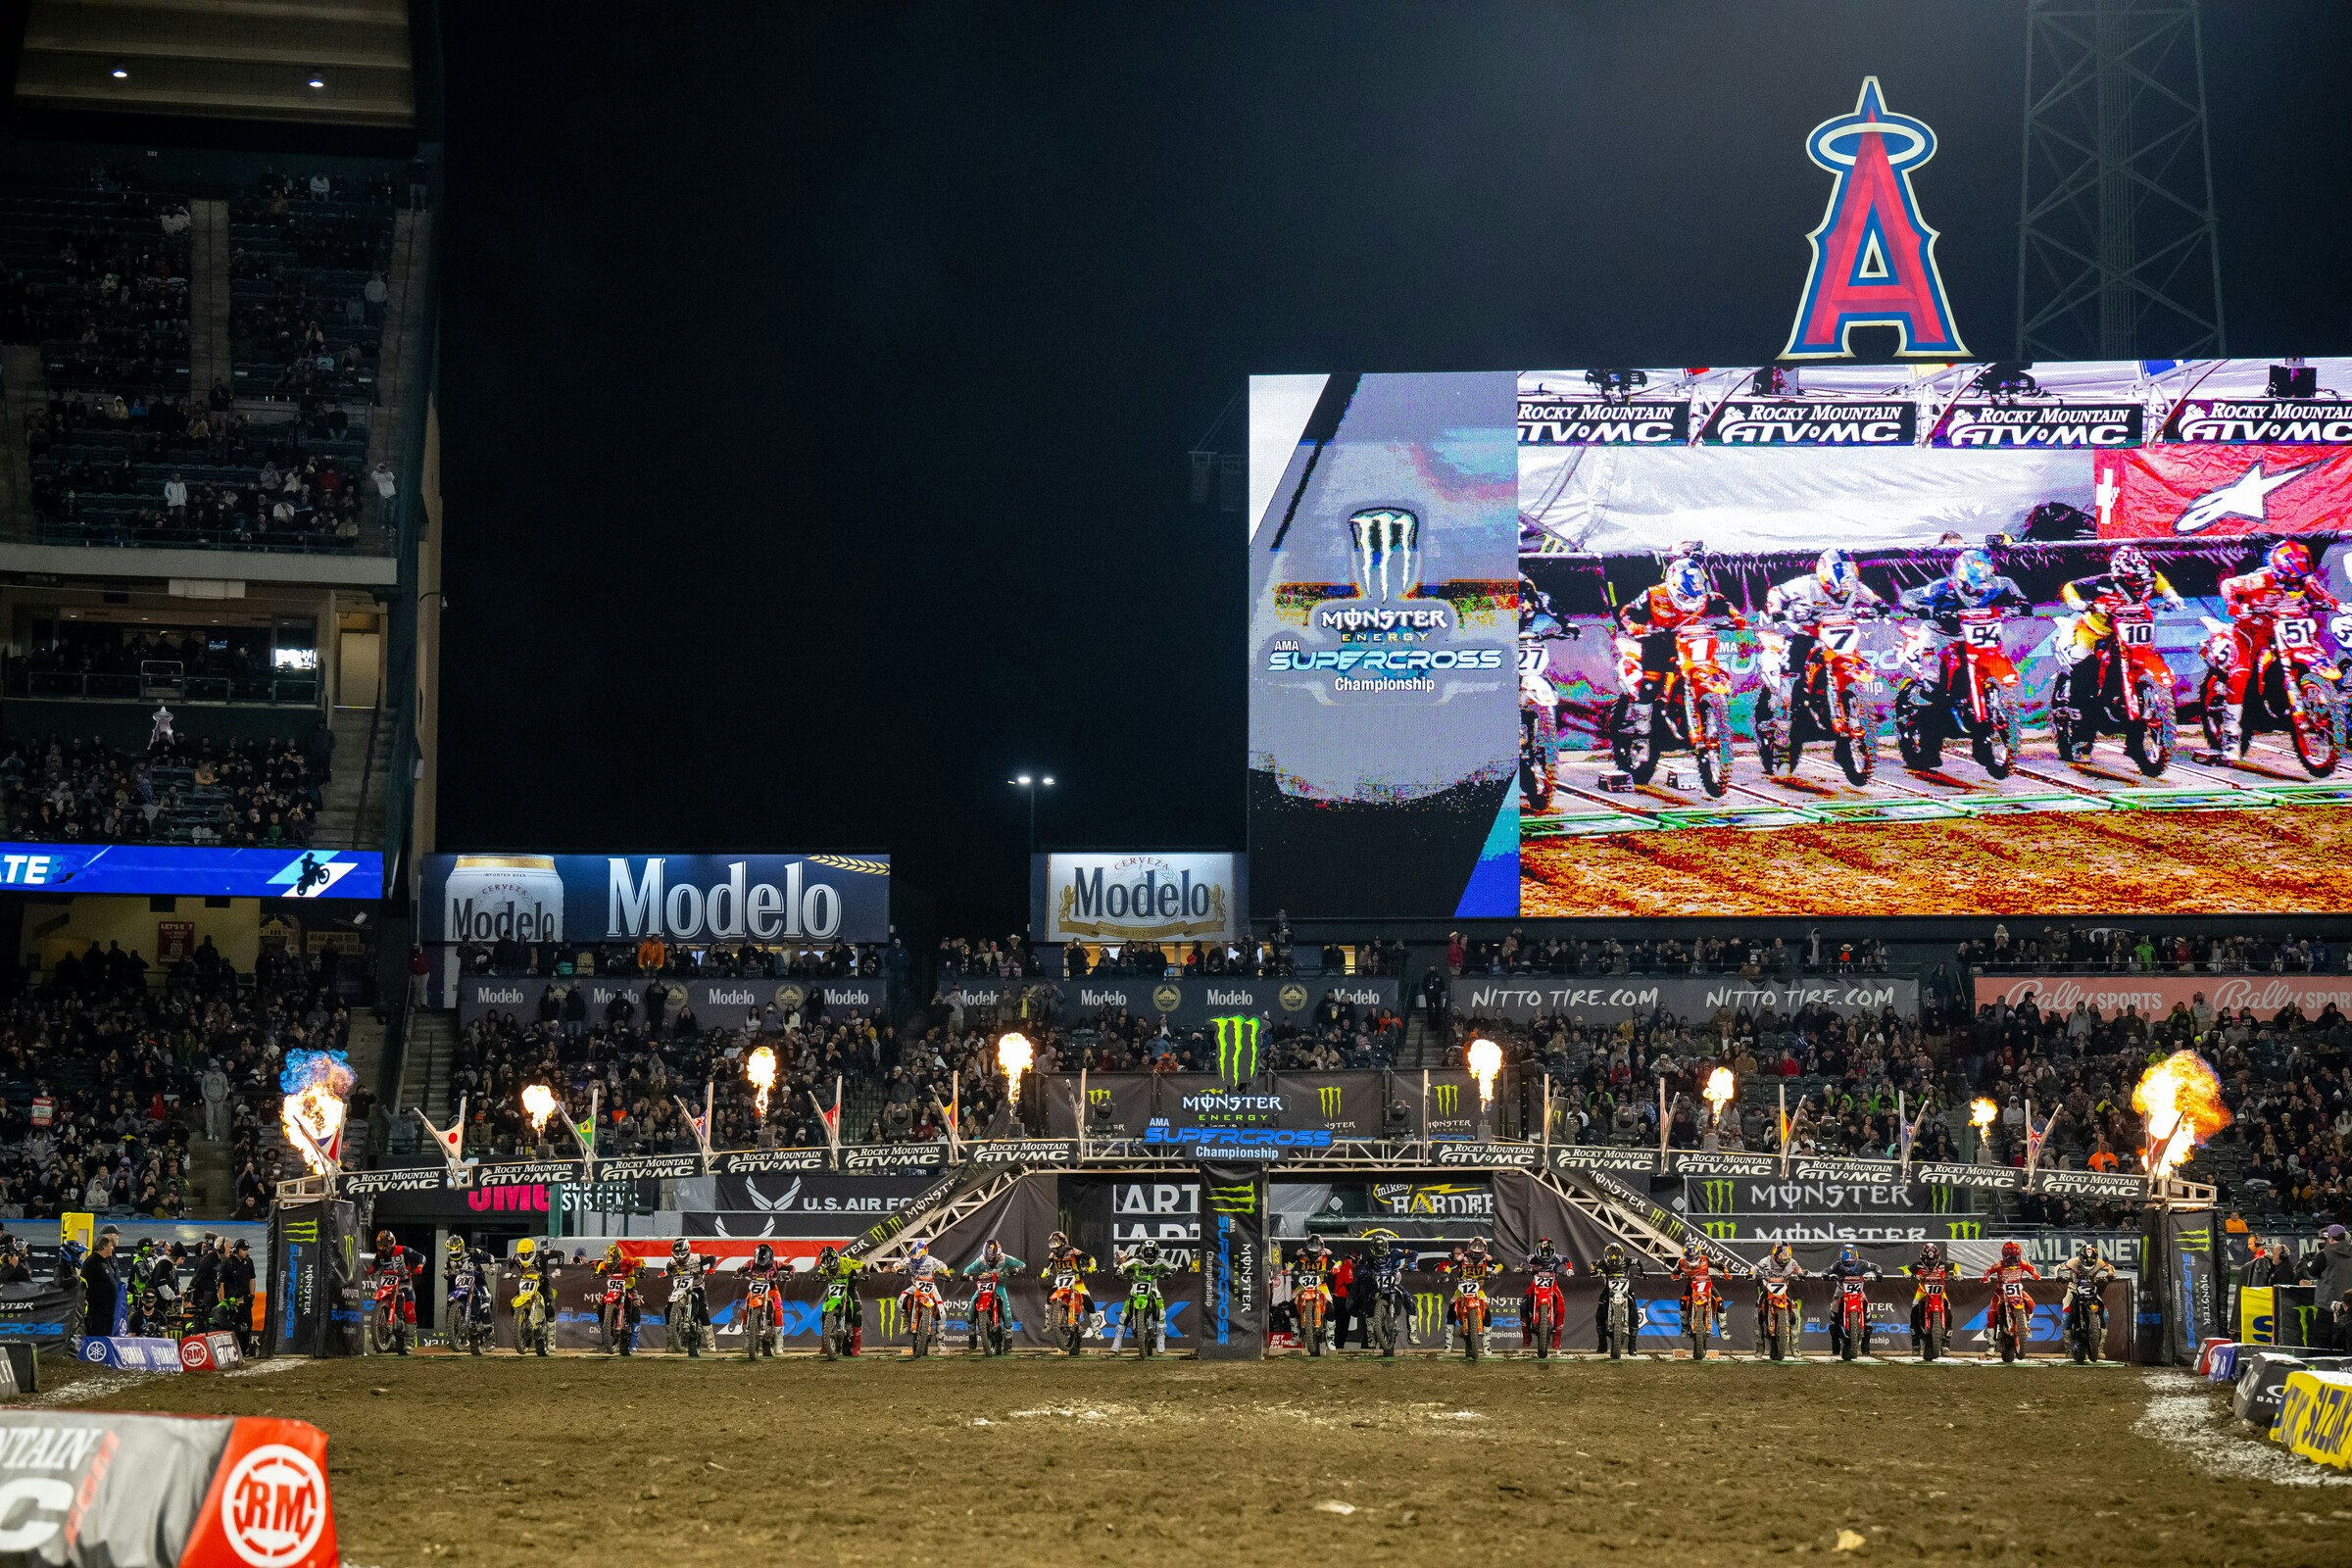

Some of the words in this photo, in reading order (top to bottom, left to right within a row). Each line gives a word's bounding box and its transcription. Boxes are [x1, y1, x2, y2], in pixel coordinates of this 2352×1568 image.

[1518, 404, 1574, 419] ROCKY
[1578, 405, 1675, 420] MOUNTAIN
[1748, 404, 1808, 420] ROCKY
[1810, 405, 1903, 420] MOUNTAIN
[1977, 407, 2038, 423] ROCKY
[2040, 408, 2129, 423] MOUNTAIN
[2209, 403, 2270, 418] ROCKY
[2270, 403, 2352, 419] MOUNTAI
[1321, 608, 1448, 631] MONSTER
[1341, 633, 1430, 642] ENERGY
[2125, 624, 2151, 645] 10
[2284, 620, 2313, 644] 51
[1274, 640, 1299, 651] AMA
[1829, 629, 1854, 651] 7
[1689, 638, 1709, 662] 1
[1267, 650, 1504, 671] SUPERCROSS
[1334, 676, 1435, 693] Championship
[0, 855, 51, 884] TE
[1113, 856, 1171, 871] CERVEZA
[481, 883, 527, 896] CERVEZA
[1073, 866, 1210, 918] Modelo
[606, 858, 843, 940] Modelo
[451, 897, 556, 942] Modelo
[477, 987, 524, 1004] Modelo
[709, 988, 755, 1004] Modelo
[823, 988, 869, 1004] Modelo
[1080, 989, 1127, 1005] Modelo
[1206, 989, 1253, 1005] Modelo
[1471, 986, 1543, 1008] NITTO
[1548, 986, 1659, 1008] TIRE.COM
[1705, 985, 1777, 1008] NITTO
[1784, 986, 1894, 1008] TIRE.COM
[2096, 992, 2163, 1010] SPORTS
[2305, 992, 2352, 1008] SPOR
[1182, 1093, 1284, 1115] MONSTER
[1150, 1117, 1170, 1127] AMA
[1143, 1127, 1333, 1147] SUPERCROSS
[859, 1148, 890, 1156] ROCKY
[891, 1146, 940, 1155] MOUNTAIN
[989, 1143, 1018, 1152] ROCKY
[1019, 1142, 1069, 1152] MOUNTAIN
[1196, 1146, 1280, 1160] Championship
[1453, 1144, 1484, 1153] ROCKY
[1485, 1145, 1536, 1154] MOUNTAIN
[741, 1152, 771, 1161] ROCKY
[772, 1151, 822, 1159] MOUNTAIN
[1572, 1149, 1602, 1157] ROCKY
[1603, 1150, 1654, 1160] MOUNTAIN
[1691, 1153, 1721, 1162] ROCKY
[1722, 1154, 1773, 1165] MOUNTAIN
[494, 1165, 523, 1174] ROCKY
[524, 1163, 572, 1173] MOUNTAIN
[614, 1160, 644, 1169] ROCKY
[645, 1157, 695, 1167] MOUNTAIN
[1812, 1160, 1842, 1169] ROCKY
[1843, 1162, 1893, 1172] MOUNTAIN
[1934, 1163, 1964, 1174] ROCKY
[1965, 1166, 2015, 1177] MOUNTAIN
[361, 1173, 391, 1183] ROCKY
[392, 1170, 439, 1181] MOUNTAIN
[2058, 1173, 2088, 1182] ROCKY
[2089, 1175, 2140, 1187] MOUNTAIN
[905, 1175, 966, 1219] MONSTE
[1113, 1184, 1200, 1213] ART
[1750, 1180, 1913, 1209] MONSTER
[845, 1198, 882, 1211] AIR
[381, 1276, 398, 1286] 78
[674, 1279, 690, 1289] 15
[1204, 1250, 1215, 1308] Championship
[1217, 1214, 1229, 1347] SUPERCROSS
[1240, 1243, 1251, 1313] MONSTER
[1301, 1277, 1318, 1287] 34
[1537, 1277, 1553, 1288] 23
[519, 1281, 536, 1293] 41
[609, 1280, 624, 1292] 95
[918, 1282, 933, 1293] 25
[979, 1282, 995, 1293] 54
[1135, 1283, 1151, 1296] 9
[1461, 1283, 1477, 1294] 12
[1611, 1281, 1628, 1293] 27
[1696, 1281, 1706, 1293] 1
[1770, 1284, 1785, 1295] 7
[1845, 1283, 1862, 1295] 94
[1927, 1284, 1942, 1295] 10
[2005, 1284, 2021, 1297] 51
[245, 1481, 311, 1533] RM
